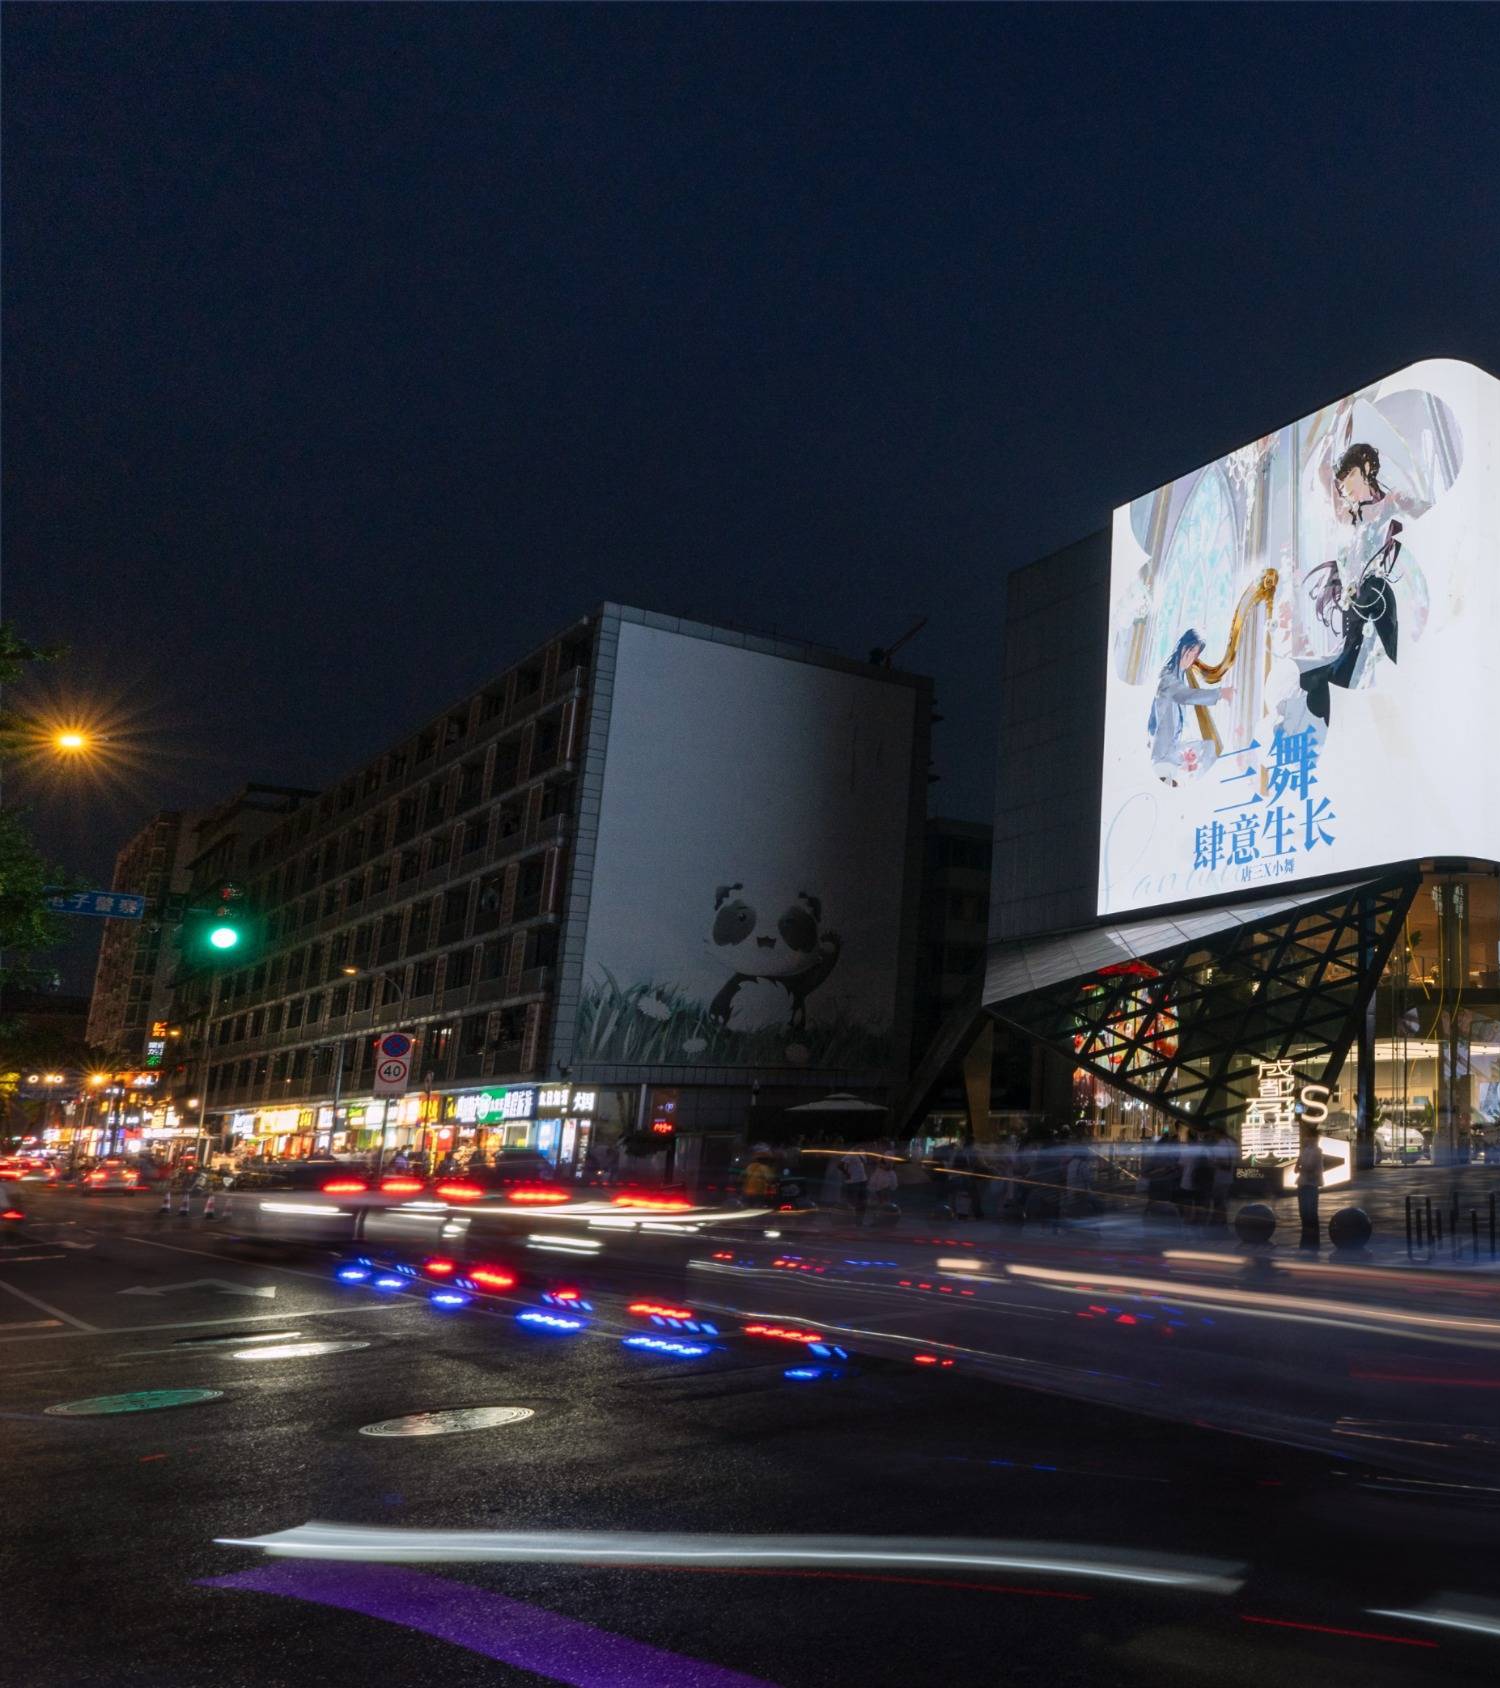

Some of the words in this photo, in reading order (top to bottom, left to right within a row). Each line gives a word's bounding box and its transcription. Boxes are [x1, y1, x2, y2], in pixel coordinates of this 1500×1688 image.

[1193, 797, 1336, 871] 肆意生长
[383, 1065, 401, 1077] 40
